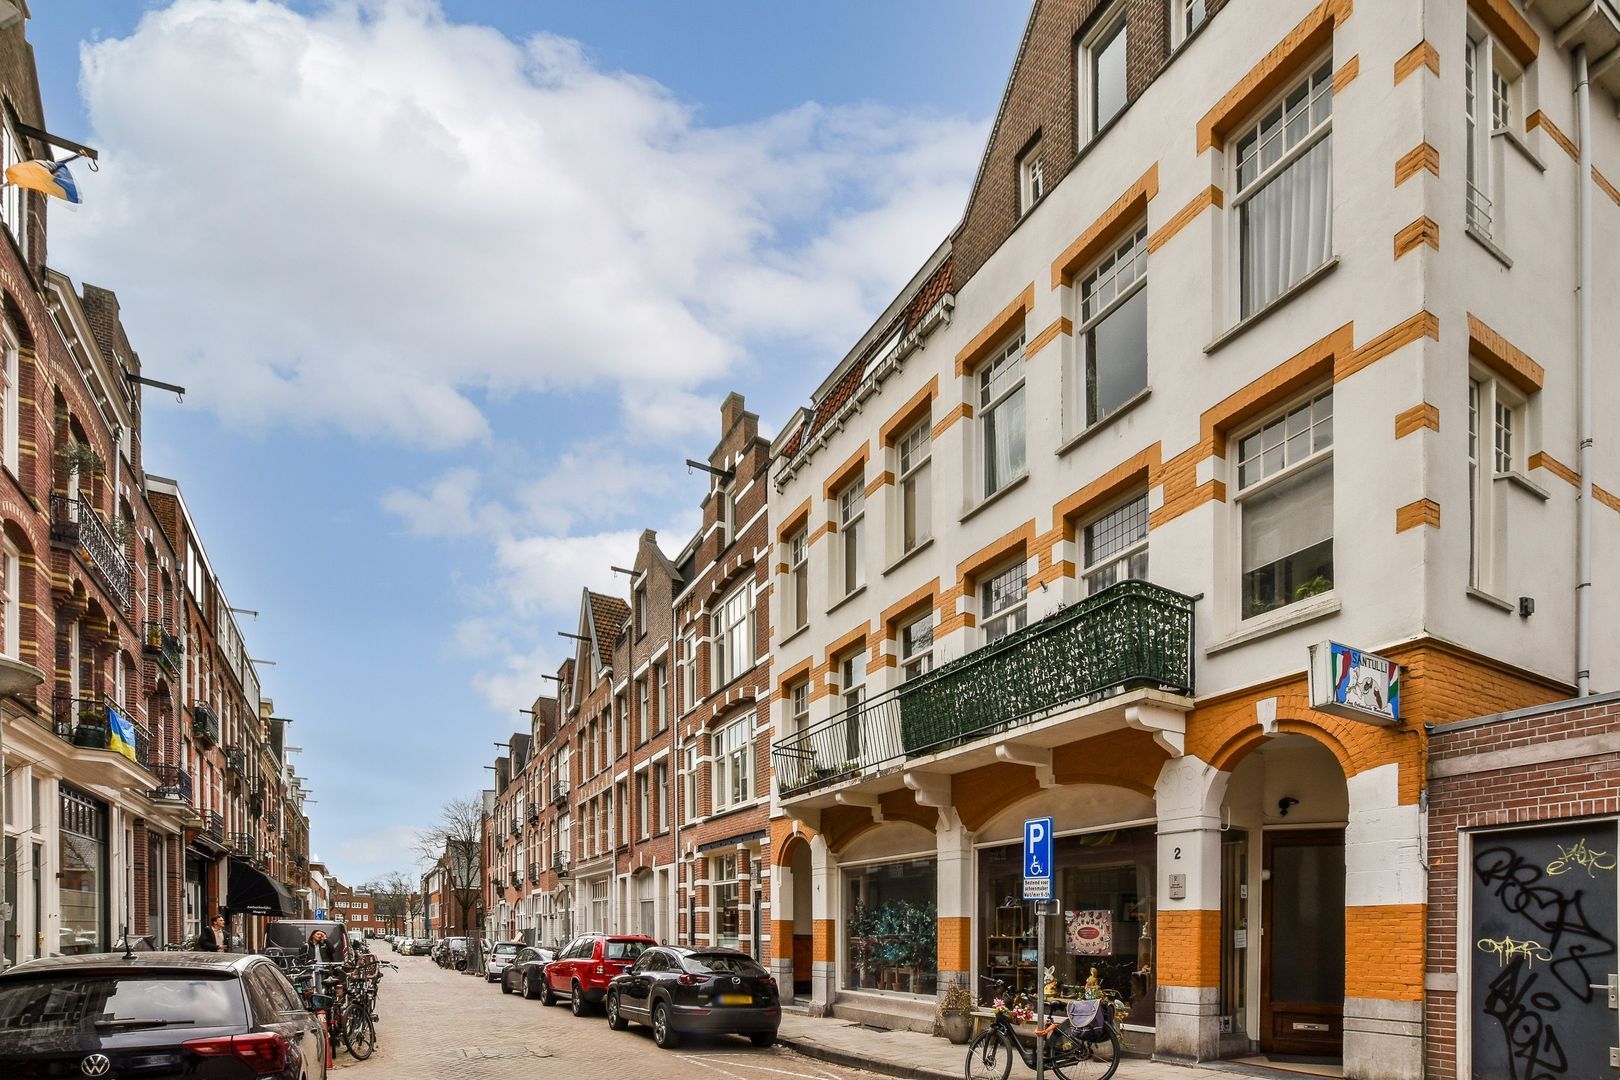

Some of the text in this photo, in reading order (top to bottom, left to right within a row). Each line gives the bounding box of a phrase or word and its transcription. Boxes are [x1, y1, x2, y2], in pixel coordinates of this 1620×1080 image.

[1352, 652, 1387, 674] SANTULLI
[1030, 824, 1044, 853] P
[1174, 847, 1181, 860] 2
